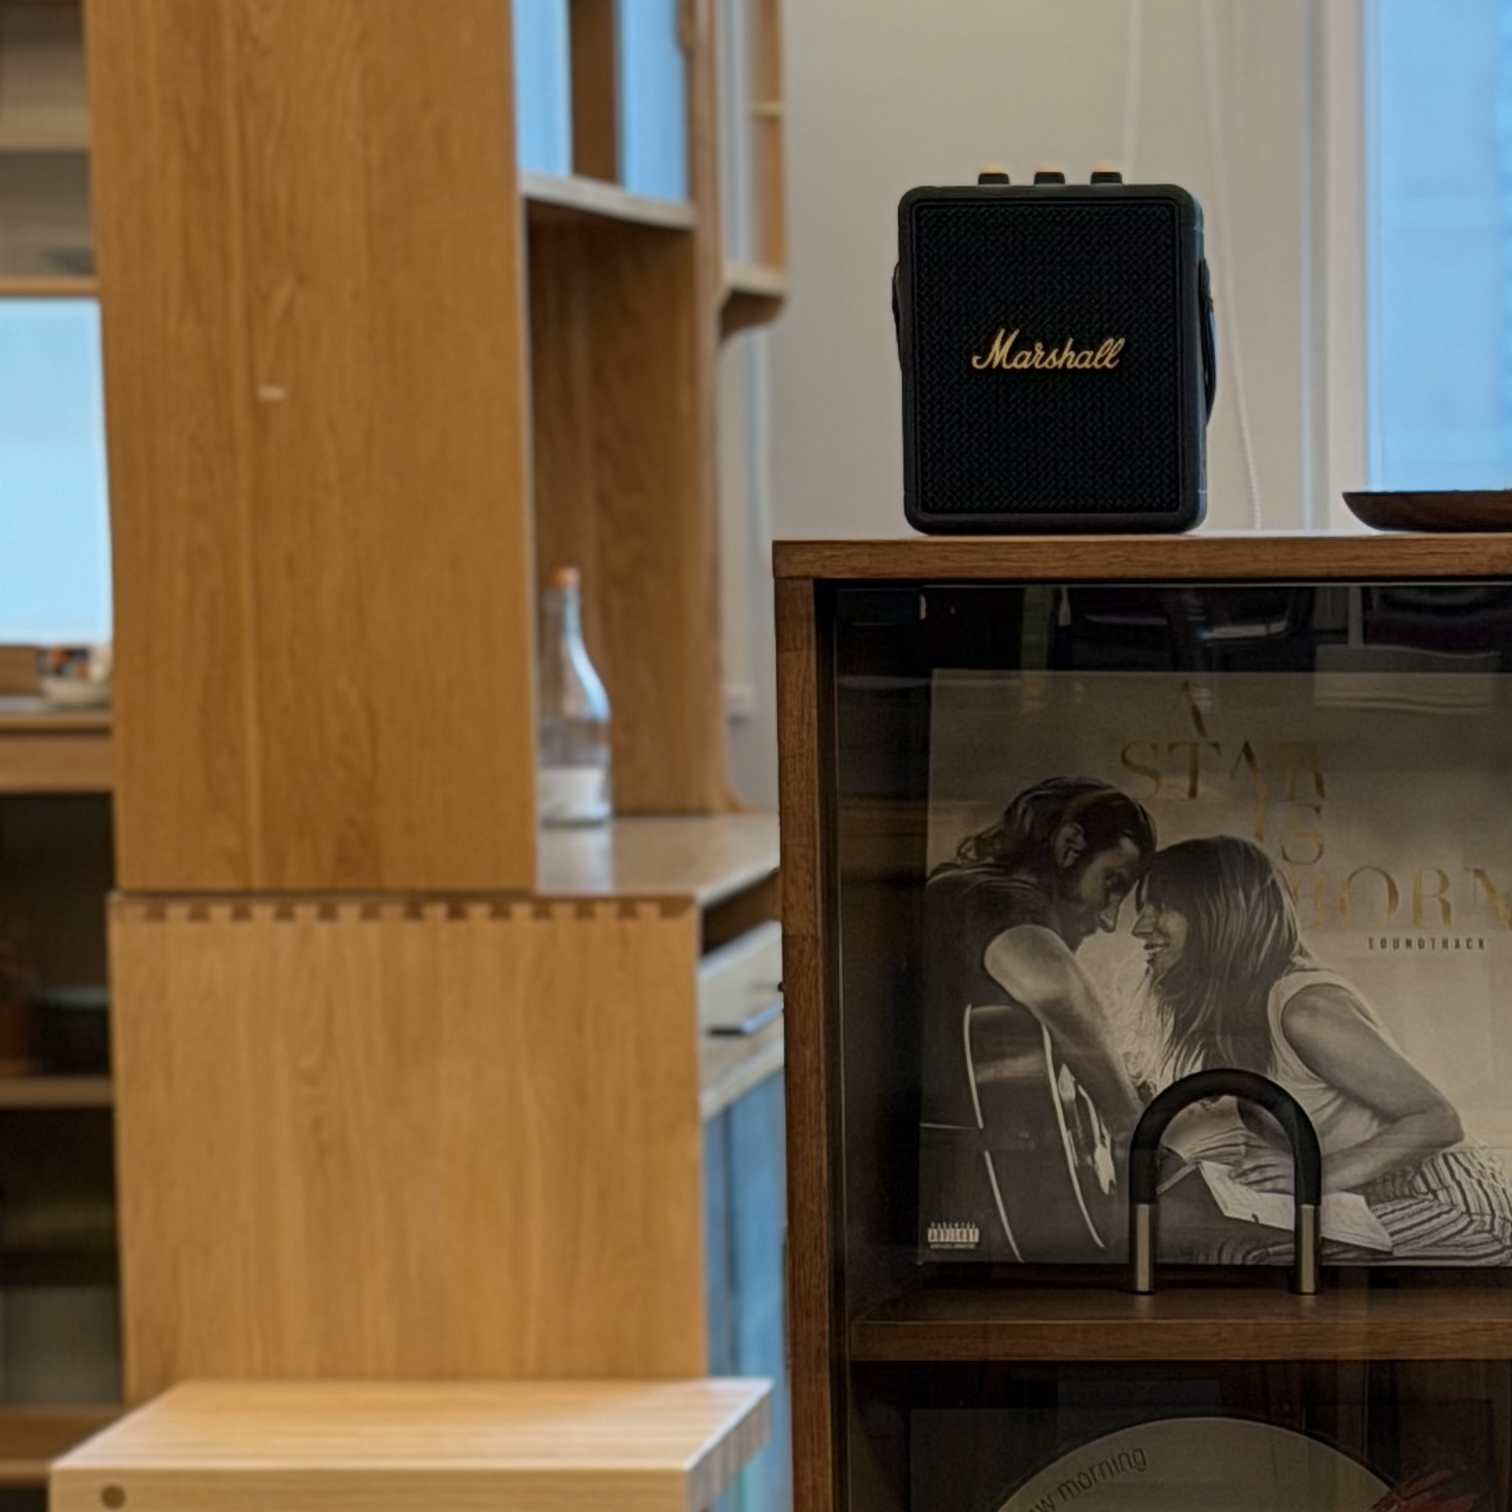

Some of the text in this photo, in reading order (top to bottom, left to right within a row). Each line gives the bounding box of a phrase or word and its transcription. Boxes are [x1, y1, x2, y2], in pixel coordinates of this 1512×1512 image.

[972, 329, 1126, 370] Marshall
[1172, 680, 1207, 737] A
[1121, 740, 1326, 800] STAR
[1368, 936, 1486, 951] SOUNDTRACK
[1057, 1448, 1146, 1500] morning
